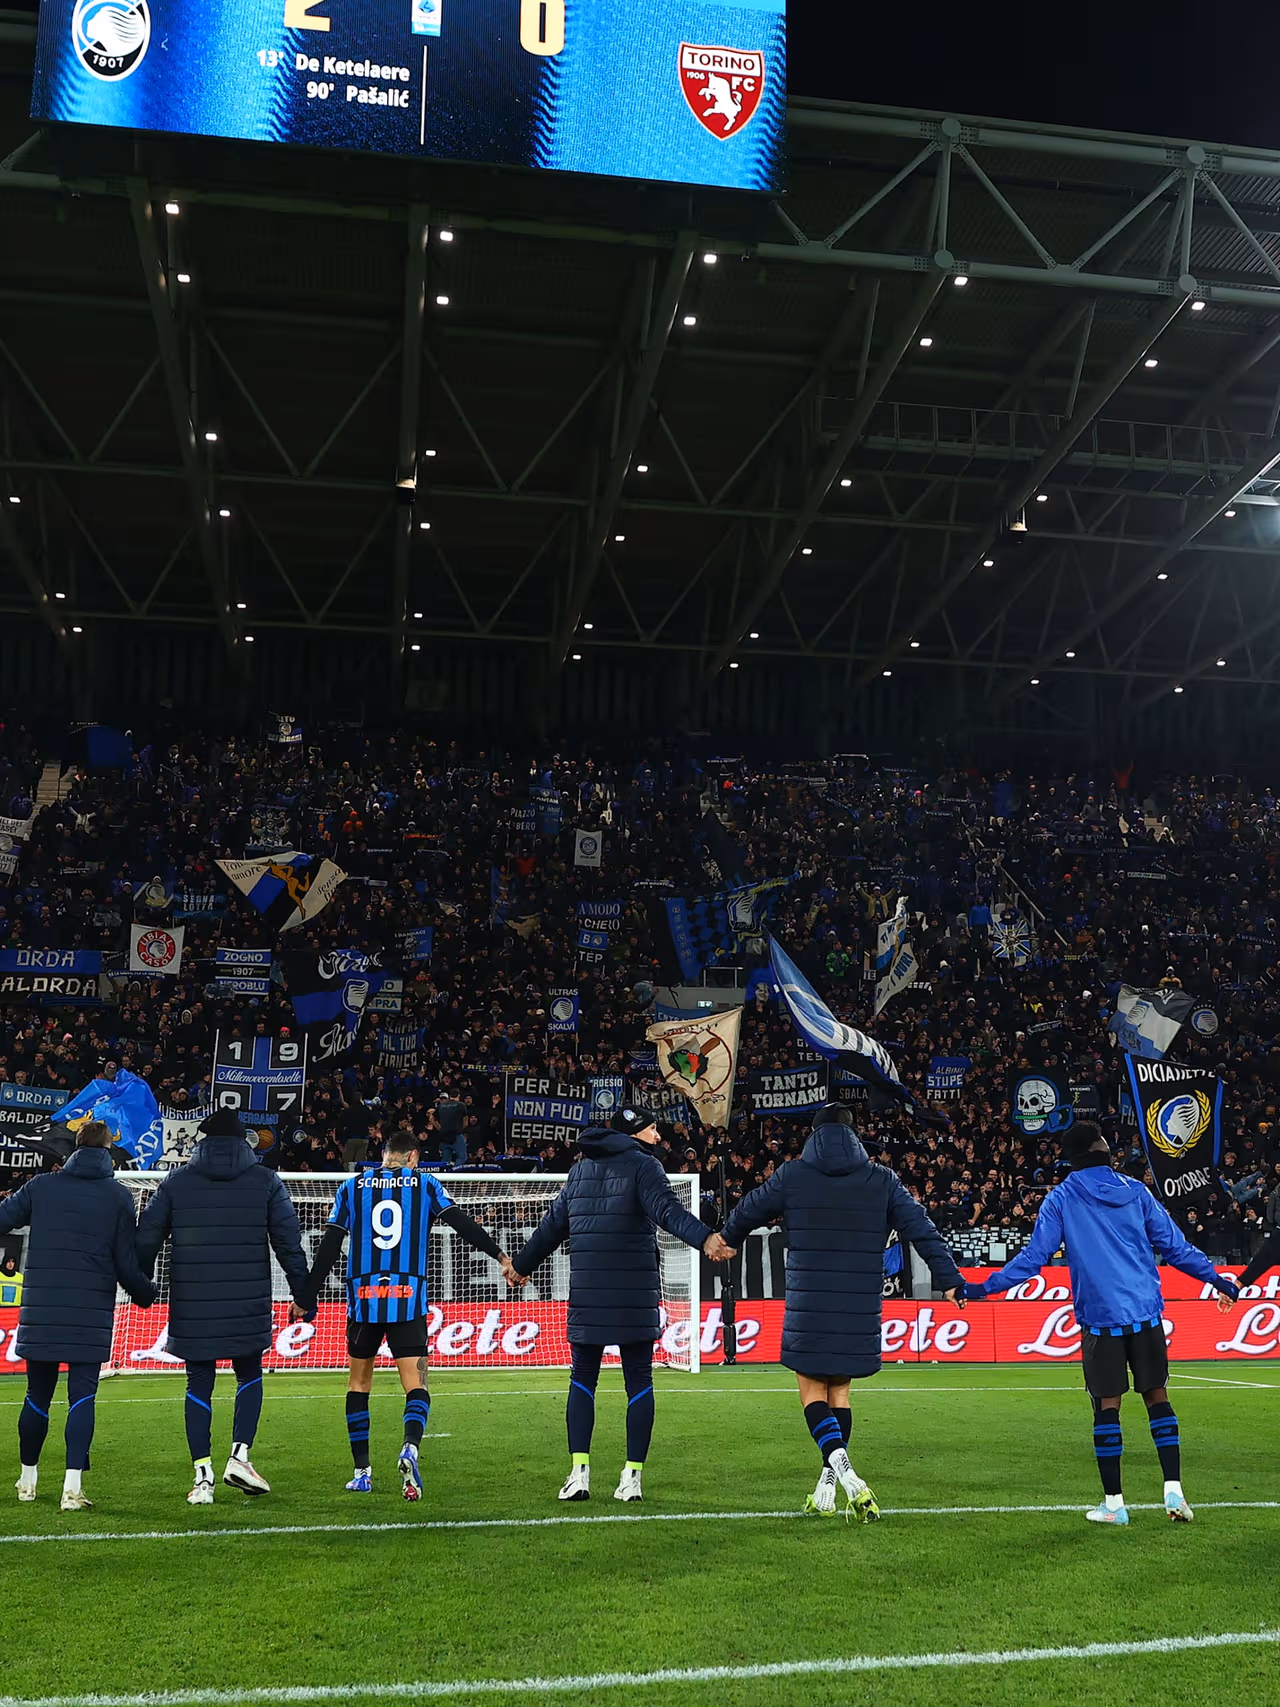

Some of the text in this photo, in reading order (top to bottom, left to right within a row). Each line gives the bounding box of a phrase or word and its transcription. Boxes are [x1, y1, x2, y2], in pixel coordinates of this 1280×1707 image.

[92, 54, 125, 69] 1907
[257, 49, 411, 82] 13' De Ketelaere
[687, 52, 755, 71] TORINO
[686, 71, 756, 92] 1906 FC
[306, 81, 410, 108] 90' Pašalić
[231, 864, 263, 881] amore
[589, 903, 620, 915] MODO
[140, 930, 173, 946] UBIAL
[16, 950, 76, 968] ORDA
[224, 951, 263, 963] ZOGNO
[231, 967, 254, 976] 1907
[548, 987, 579, 996] ULTRAS
[228, 1041, 243, 1060] 1
[279, 1042, 299, 1062] 9
[378, 1051, 418, 1068] FIANCO
[217, 1069, 302, 1084] Millenovecentosette
[935, 1065, 966, 1075] ALBINO
[514, 1077, 586, 1098] PER CHI
[760, 1071, 819, 1091] TANTO
[927, 1073, 963, 1087] STUPE
[16, 1091, 52, 1105] ORDA
[276, 1092, 297, 1111] 7
[751, 1085, 827, 1109] TORNANO
[926, 1088, 962, 1100] FATTI
[513, 1099, 545, 1118] NON
[357, 1176, 418, 1190] SCAMACCA
[372, 1199, 403, 1250] 9
